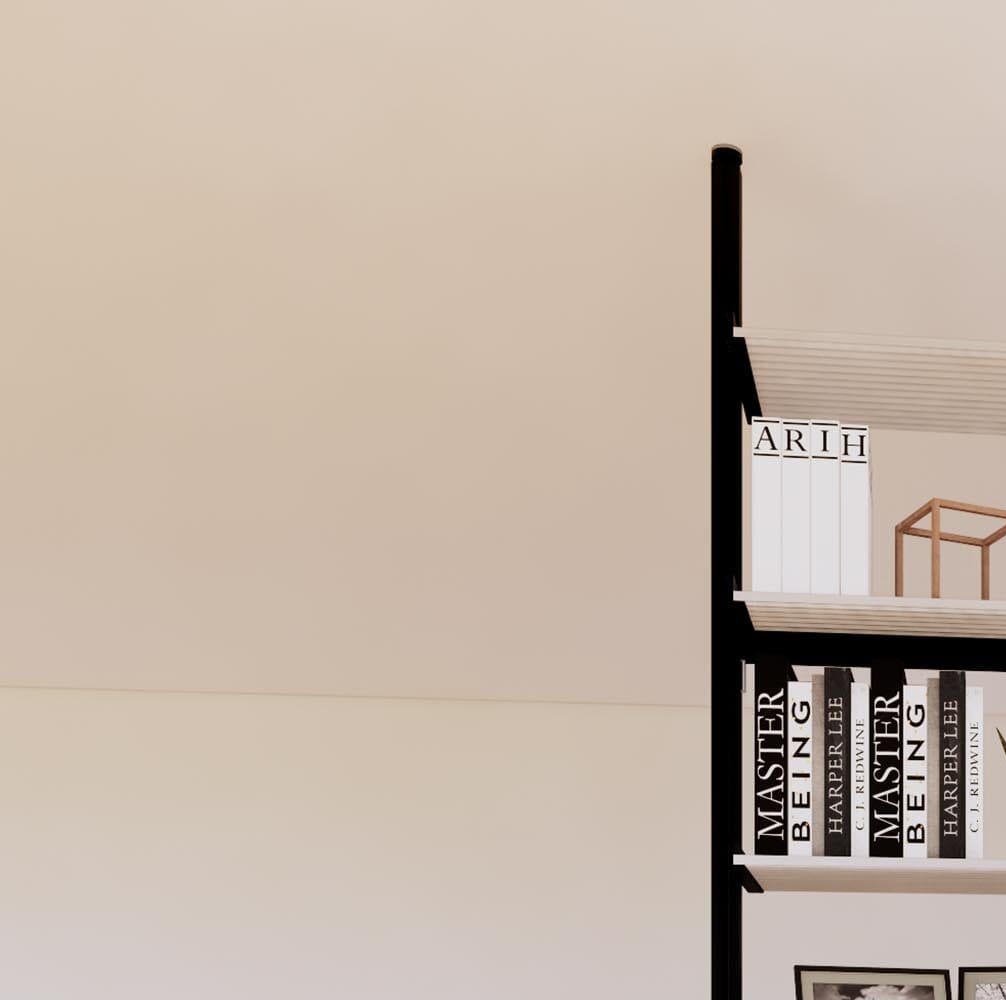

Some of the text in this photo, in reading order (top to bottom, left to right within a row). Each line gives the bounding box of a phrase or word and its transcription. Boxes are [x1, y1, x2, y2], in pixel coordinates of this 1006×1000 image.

[756, 688, 784, 840] MASTER
[792, 701, 810, 841] BEING
[828, 697, 843, 834] HARPER LEE
[855, 719, 865, 794] REDWINE
[873, 691, 900, 842] MASTER
[907, 704, 925, 843] BEING
[944, 700, 958, 837] HARPER LEE
[970, 721, 979, 796] REDWINE
